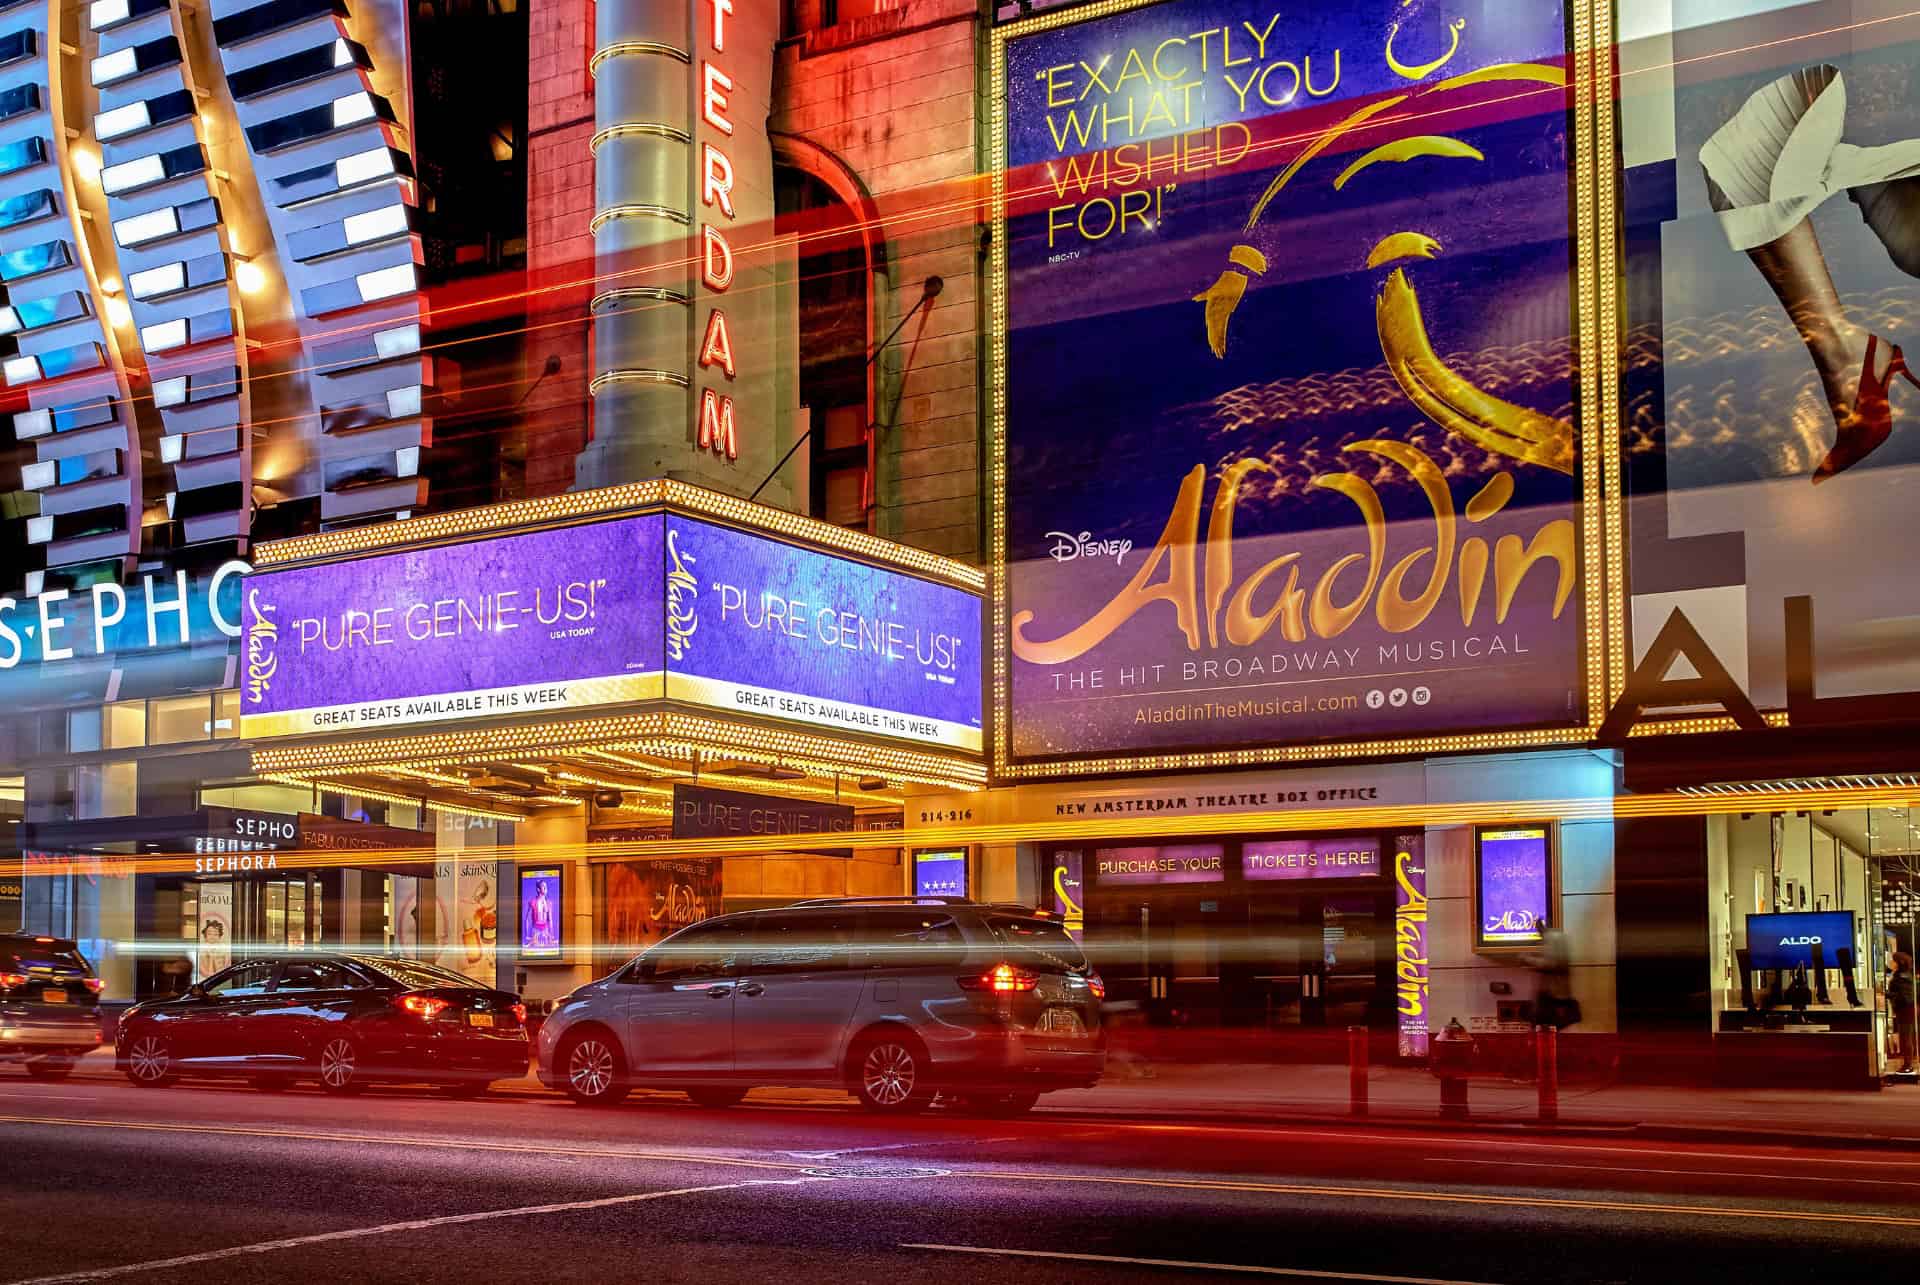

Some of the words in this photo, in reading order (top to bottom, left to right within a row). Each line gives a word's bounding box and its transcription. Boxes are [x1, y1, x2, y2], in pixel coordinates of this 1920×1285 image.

[1036, 13, 1280, 108] “EXACTLY
[1047, 84, 1197, 153] WHAT
[1225, 49, 1341, 111] YOU
[1047, 122, 1252, 199] WISHED
[1048, 184, 1177, 247] FOR!”
[1048, 252, 1080, 264] NBC-TV
[1011, 440, 1576, 664] Aladdin
[667, 529, 699, 661] Aladdin
[712, 581, 808, 639] “PURE
[248, 588, 278, 703] Aladdin
[292, 608, 394, 655] “PURE
[550, 629, 567, 640] USA
[568, 626, 595, 638] TODAY
[1050, 669, 1104, 692] THE
[1119, 664, 1166, 687] HIT
[1181, 647, 1361, 682] BROADWAY
[1378, 633, 1530, 663] MUSICAL
[313, 710, 356, 727] GREAT
[360, 705, 401, 721] SEATS
[405, 696, 483, 717] AVAILABLE
[488, 692, 519, 708] THIS
[524, 687, 568, 704] WEEK
[735, 690, 777, 710] GREAT
[779, 698, 816, 716] SEATS
[818, 704, 879, 727] AVAILABLE
[882, 715, 906, 731] THIS
[907, 719, 939, 737] WEEK
[1134, 691, 1360, 726] AladdinTheMusical.com
[920, 808, 973, 823] 214-216
[1056, 802, 1086, 816] NEW
[1093, 797, 1188, 814] AMSTERDAM
[1196, 792, 1269, 808] THEATRE
[1277, 791, 1308, 803] BOX
[1318, 786, 1378, 802] OFFICE
[235, 818, 295, 839] SEPHO
[195, 854, 278, 873] SEPHORA
[1099, 858, 1177, 874] PURCHASE
[1181, 856, 1221, 871] YOUR
[1247, 853, 1318, 869] TICKETS
[1395, 851, 1429, 1016] Aladdin
[1779, 936, 1822, 946] ALDO
